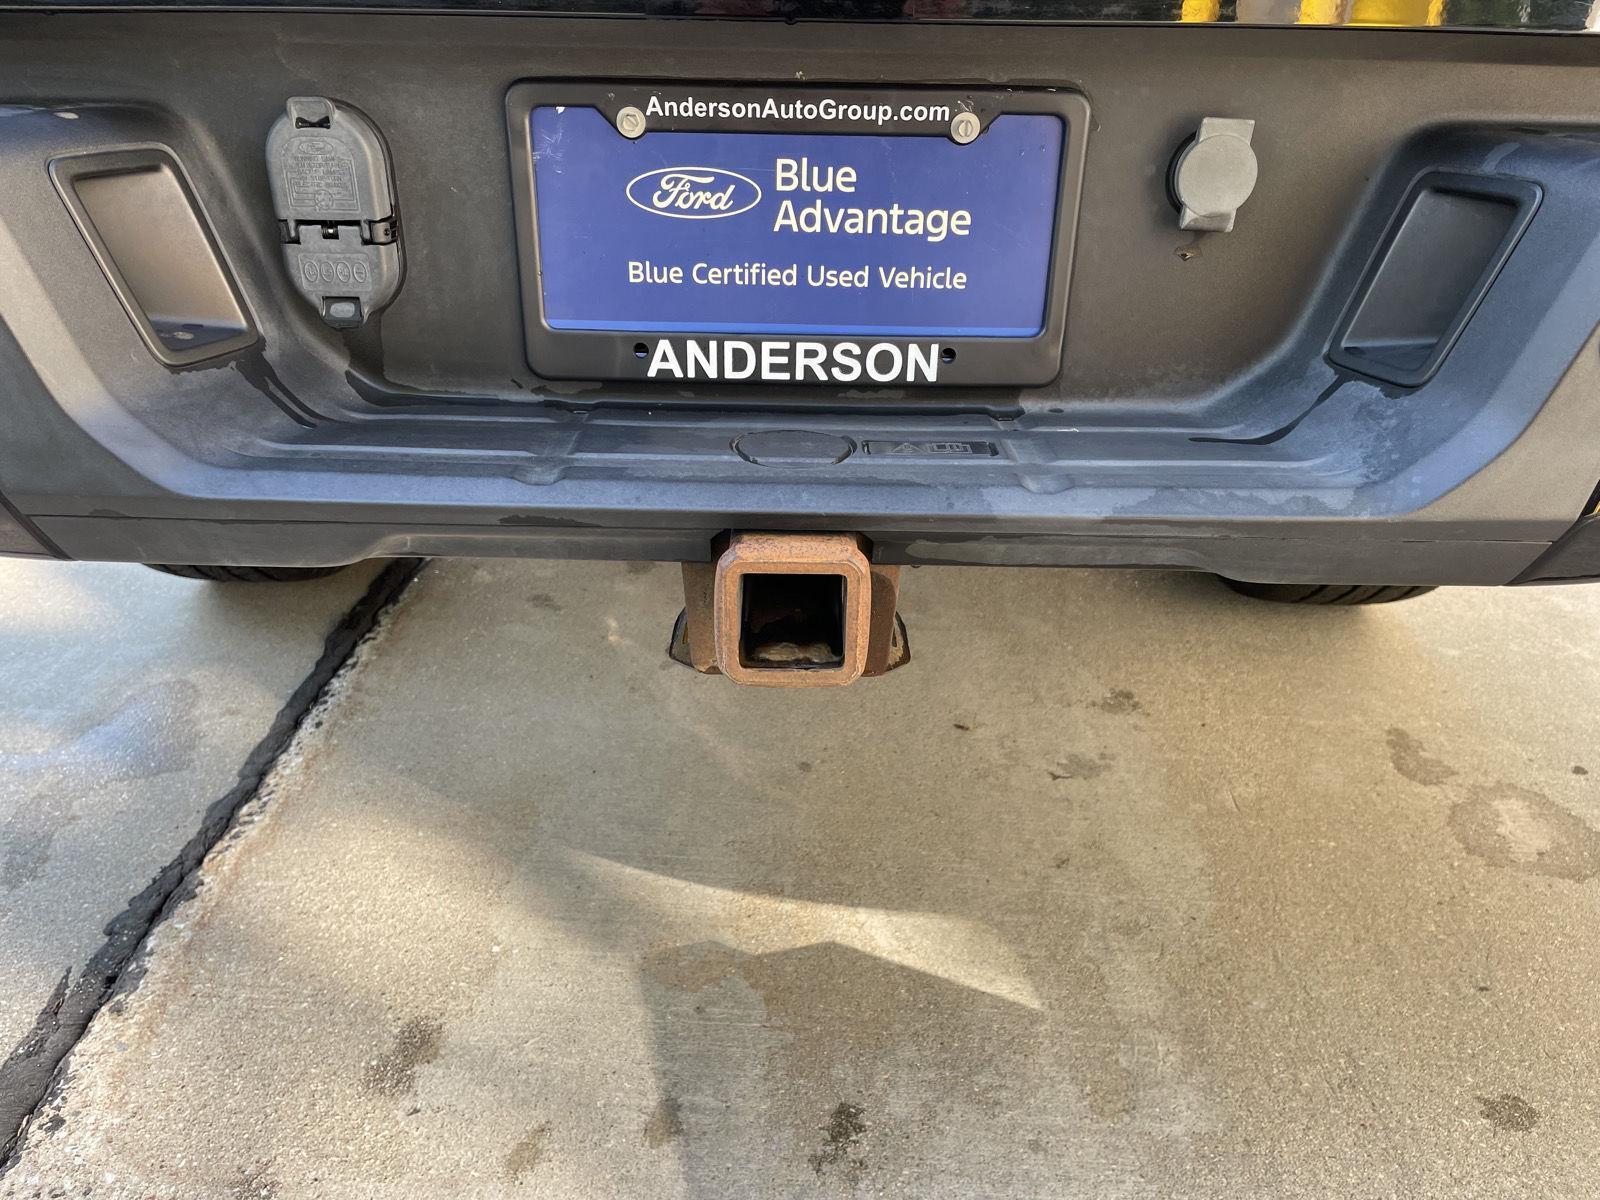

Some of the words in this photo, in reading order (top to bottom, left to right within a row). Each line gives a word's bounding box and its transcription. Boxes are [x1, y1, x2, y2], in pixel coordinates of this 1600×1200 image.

[645, 95, 951, 126] AndersonAutoGroup.com
[652, 172, 734, 212] Ford
[775, 157, 857, 193] Blue
[773, 199, 972, 243] Advantage
[628, 260, 684, 284] Blue
[691, 262, 798, 287] Certified
[807, 264, 870, 288] Used
[878, 265, 968, 290] Vehicle
[646, 338, 940, 383] ANDERSON
